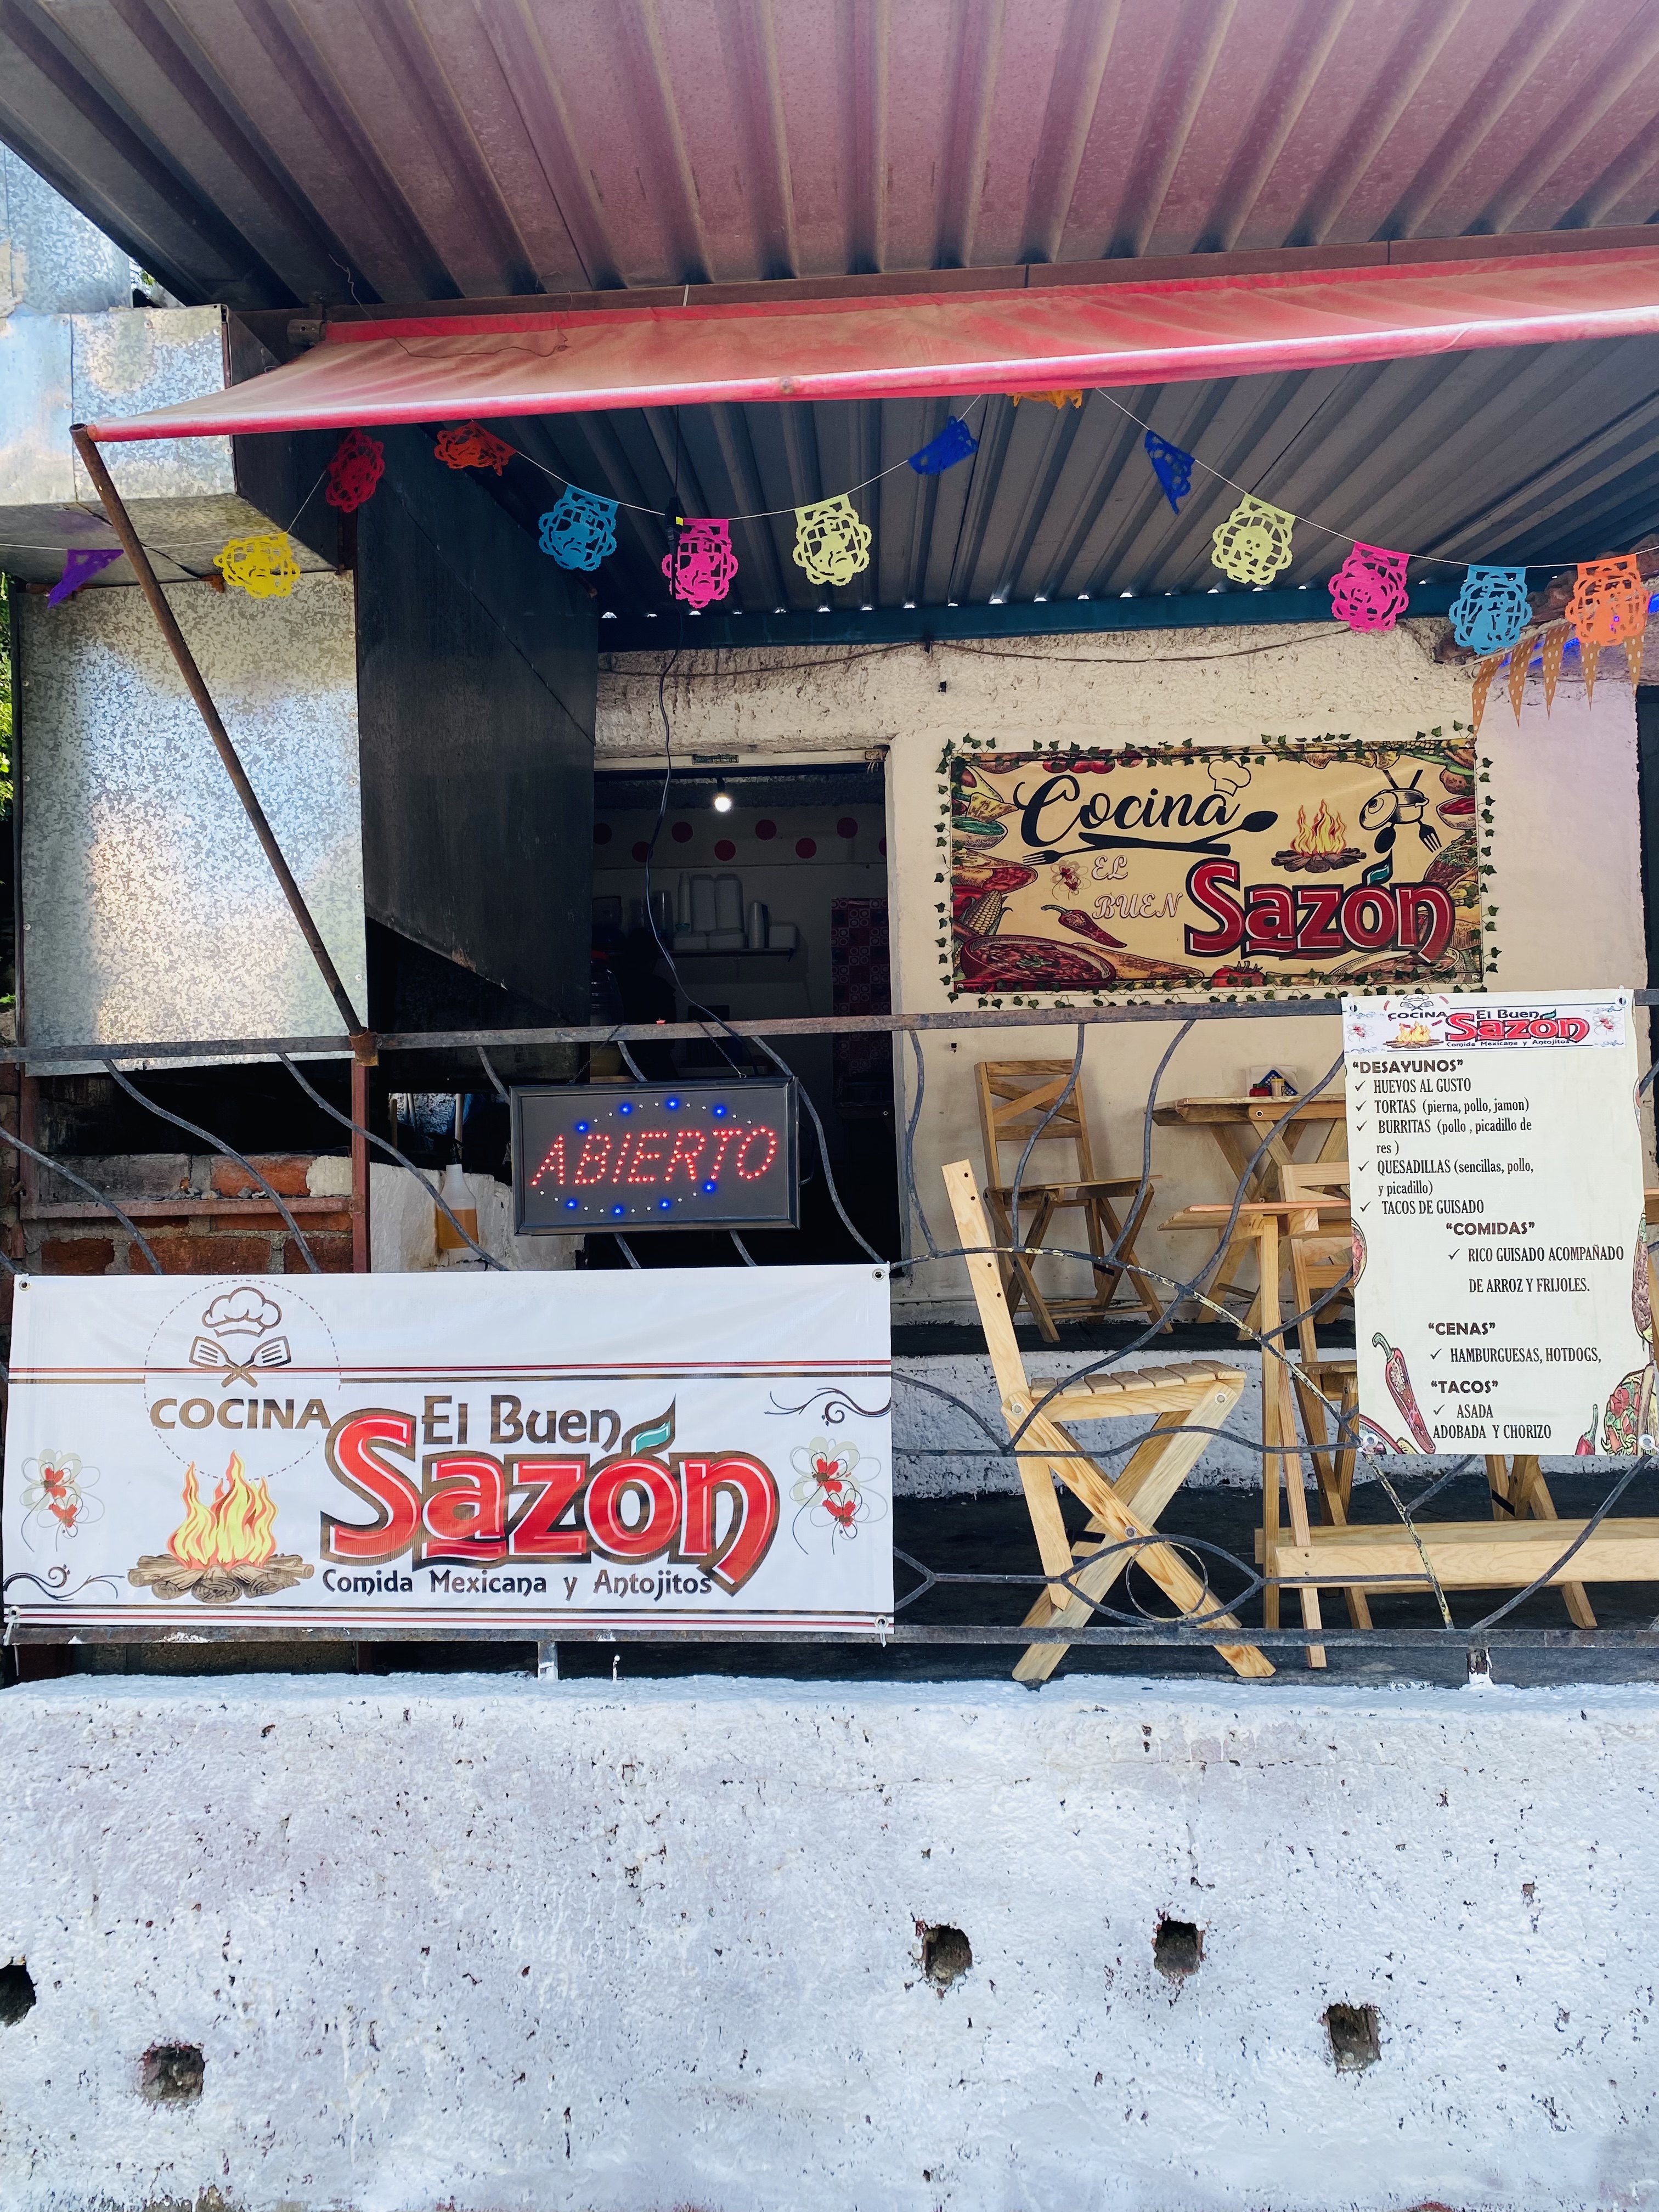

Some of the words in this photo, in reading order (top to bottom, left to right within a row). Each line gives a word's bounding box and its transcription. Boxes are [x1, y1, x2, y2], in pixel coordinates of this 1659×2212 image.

[1014, 775, 1240, 847] Cocina
[1092, 855, 1128, 881] EL
[1092, 893, 1183, 921] BUEN
[1184, 849, 1456, 965] Sazón
[1387, 1012, 1448, 1020] COCINA
[1476, 1010, 1490, 1019] El
[1497, 1009, 1539, 1020] Buen
[1444, 1009, 1590, 1043] Sazón
[1374, 1080, 1416, 1093] HUEVOS
[1420, 1079, 1433, 1092] AL
[1437, 1078, 1471, 1092] GUSTO
[1375, 1099, 1415, 1113] TORTAS
[1423, 1100, 1460, 1115] (pierna,
[1464, 1098, 1491, 1114] pollo,
[1493, 1098, 1528, 1113] jamon)
[1379, 1119, 1430, 1133] BURRITAS
[1437, 1119, 1465, 1135] (pollo
[1476, 1118, 1516, 1134] picadillo
[1521, 1118, 1531, 1130] de
[531, 1126, 777, 1187] ABIERTO
[1378, 1160, 1451, 1176] QUESADILLAS
[1454, 1159, 1504, 1174] (sencillas,
[1508, 1158, 1533, 1174] pollo,
[1379, 1186, 1384, 1197] y
[1387, 1181, 1432, 1197] picadillo)
[1382, 1201, 1415, 1214] TACOS
[1419, 1200, 1433, 1214] DE
[1437, 1200, 1483, 1214] GUISADO
[1468, 1248, 1492, 1261] RICO
[1497, 1248, 1544, 1261] GUISADO
[1549, 1245, 1623, 1261] ACOMPAÑADO
[1469, 1279, 1483, 1292] DE
[1487, 1279, 1523, 1292] ARROZ
[1526, 1279, 1533, 1291] Y
[1537, 1278, 1589, 1291] FRIJOLES.
[1451, 1348, 1542, 1363] HAMBURGUESAS,
[1545, 1347, 1601, 1363] HOTDOGS,
[150, 1397, 331, 1430] COCINA
[1457, 1404, 1493, 1418] ASADA
[422, 1395, 467, 1445] El
[492, 1394, 621, 1454] Buen
[1433, 1425, 1486, 1438] ADOBADA
[1492, 1425, 1499, 1438] Y
[1504, 1425, 1551, 1438] CHORIZO
[320, 1393, 780, 1597] Sazón
[323, 1569, 414, 1598] Comida
[430, 1569, 548, 1599] Mexicana
[564, 1577, 577, 1601] y
[594, 1567, 713, 1600] Antojitos
